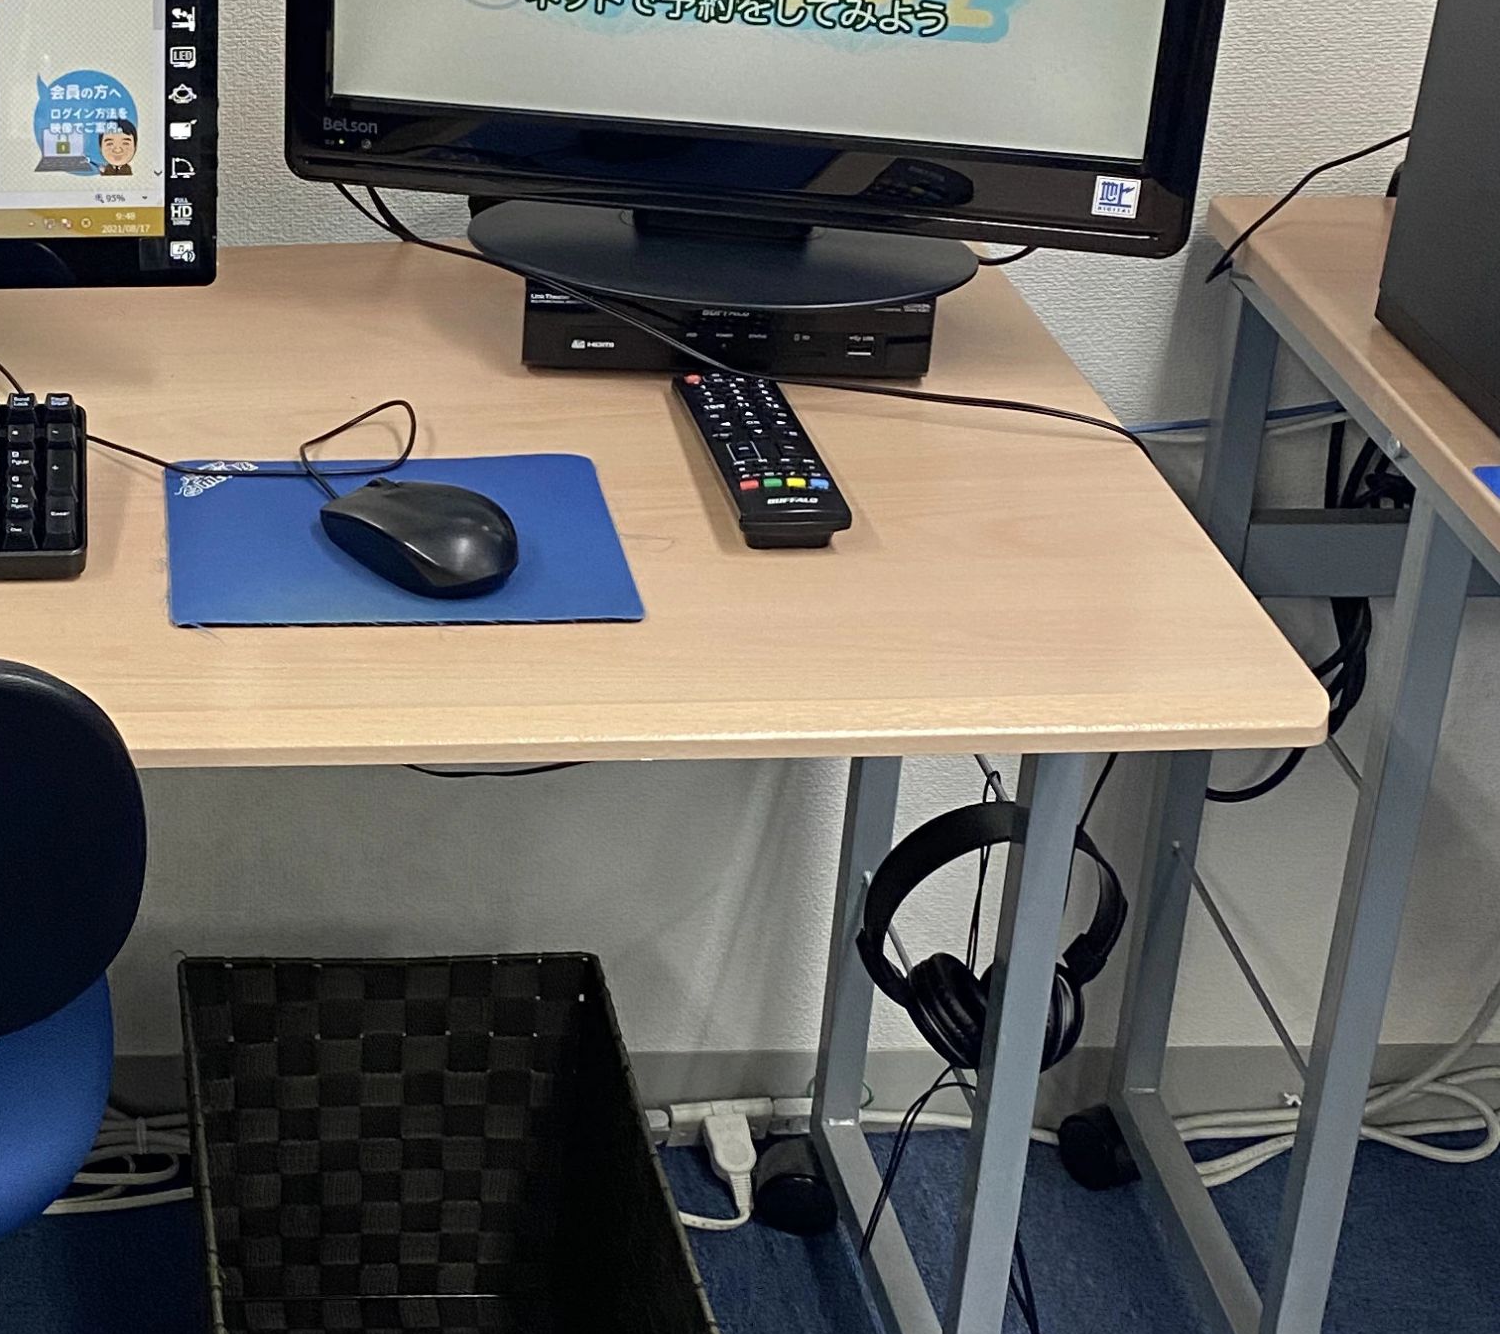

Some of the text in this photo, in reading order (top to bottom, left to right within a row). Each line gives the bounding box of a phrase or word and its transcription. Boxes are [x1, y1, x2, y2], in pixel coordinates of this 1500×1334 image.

[173, 51, 193, 61] LED
[49, 83, 122, 101] 会員の方へ
[170, 204, 193, 217] HD
[767, 496, 819, 505] BUFFALO
